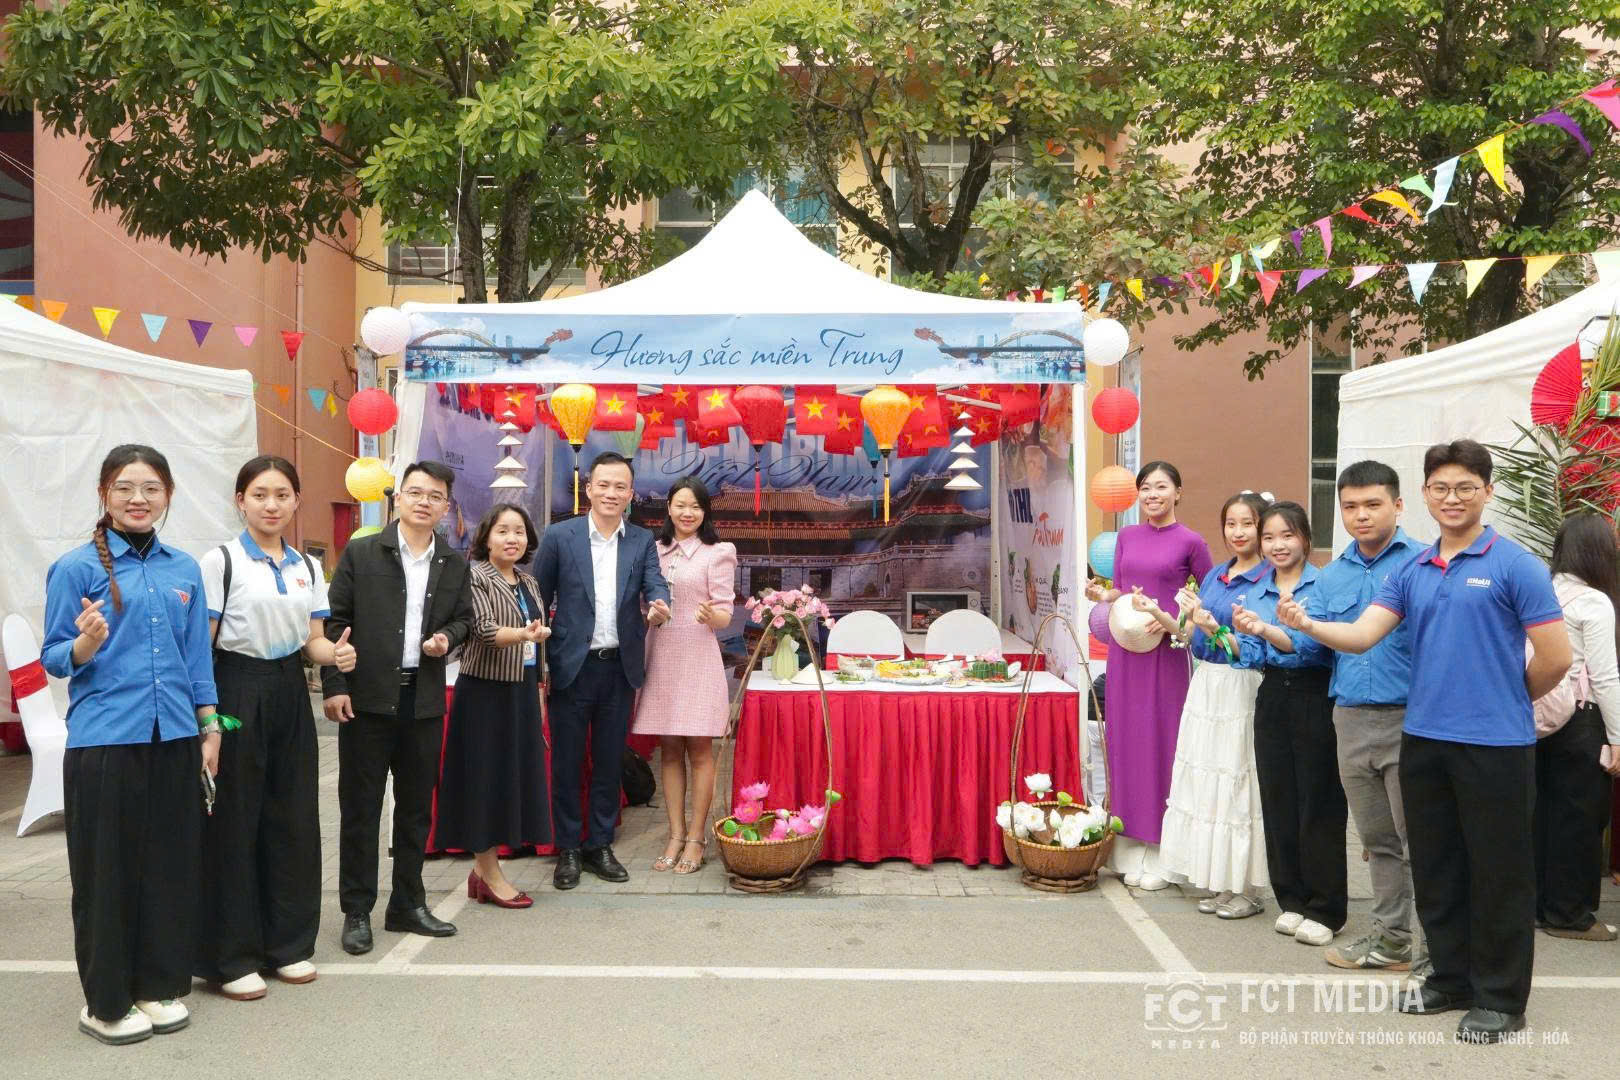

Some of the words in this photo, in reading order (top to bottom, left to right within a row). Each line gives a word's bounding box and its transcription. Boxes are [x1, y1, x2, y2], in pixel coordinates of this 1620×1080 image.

[591, 330, 692, 376] Hương
[699, 337, 742, 367] sắc
[750, 337, 812, 366] miền
[819, 328, 904, 376] Trung
